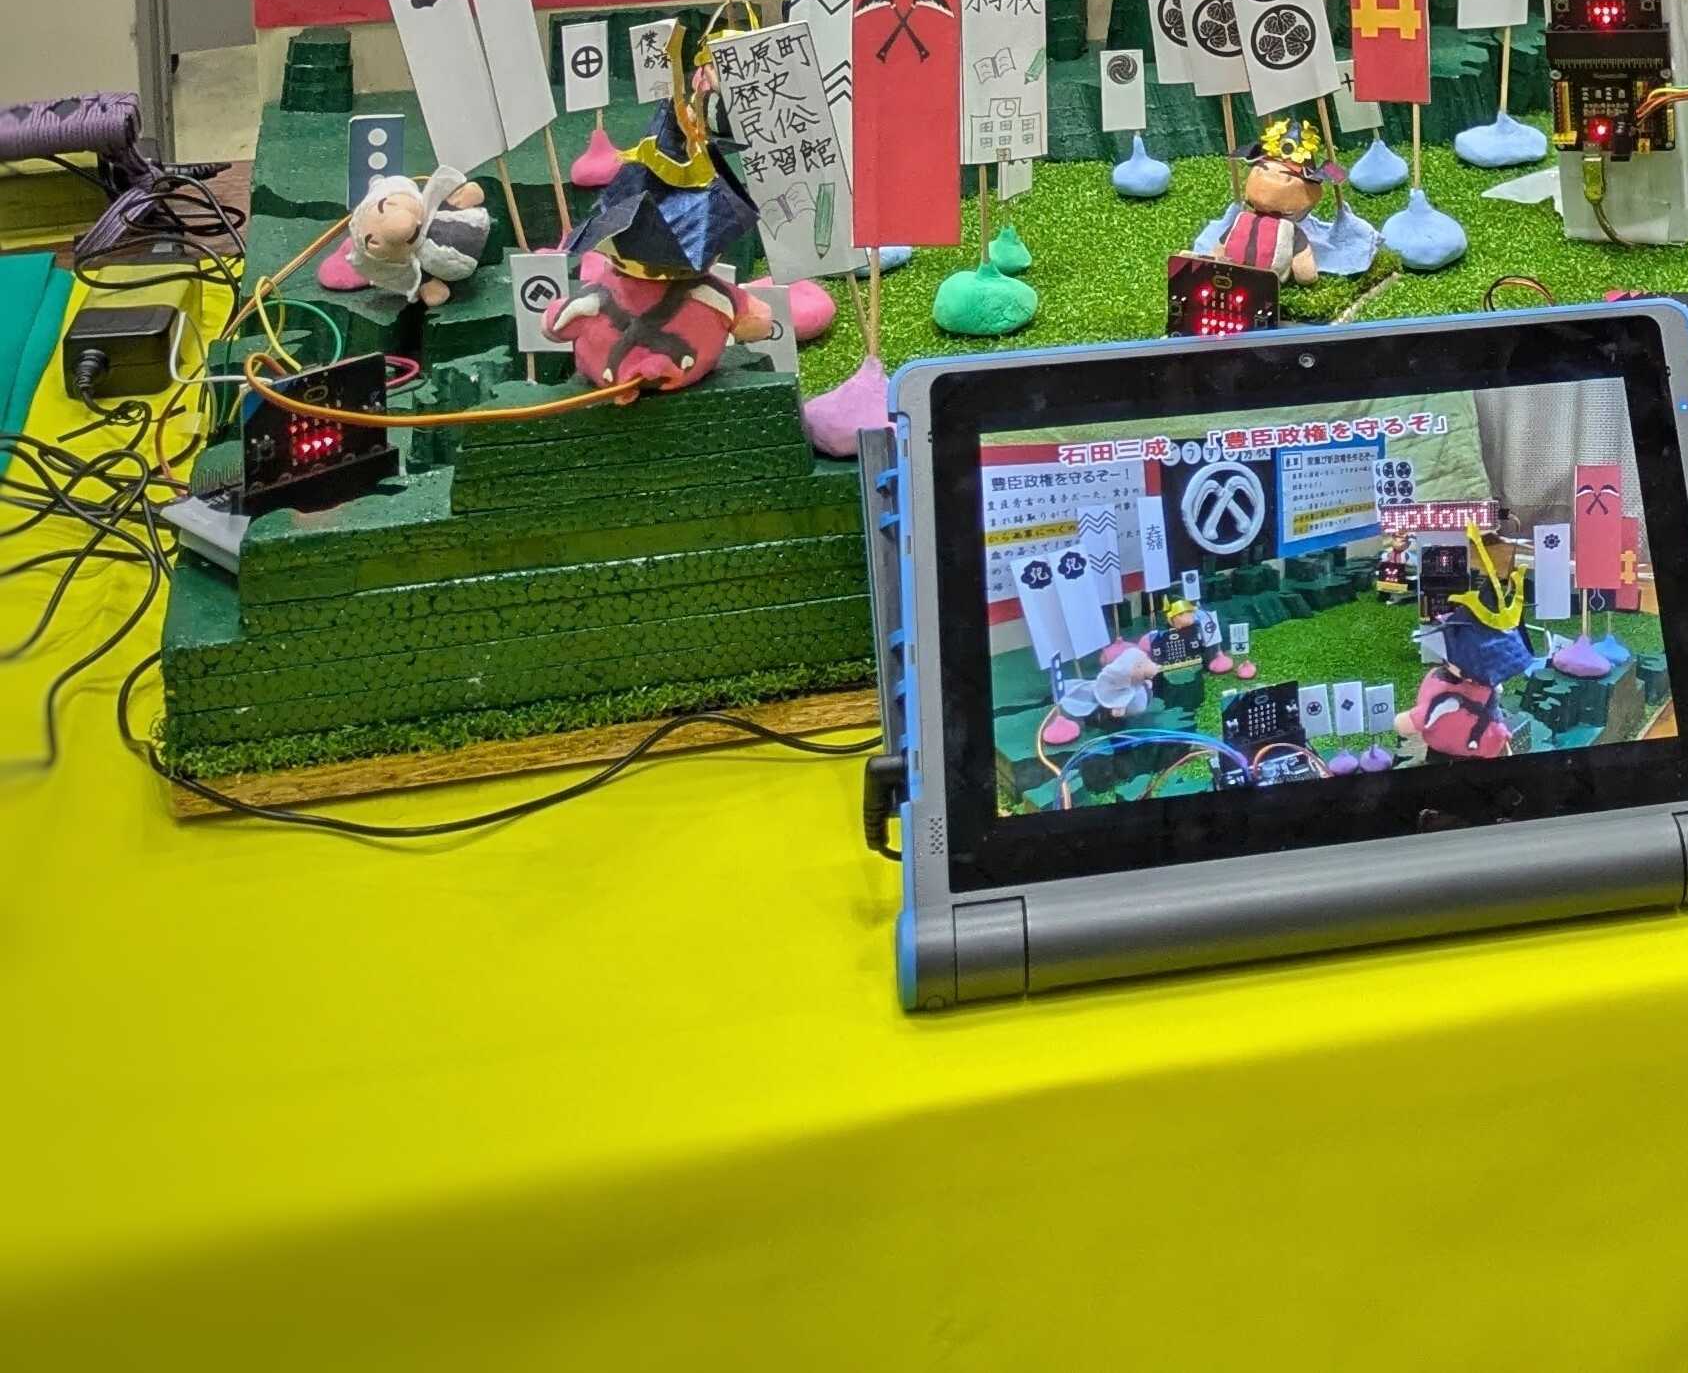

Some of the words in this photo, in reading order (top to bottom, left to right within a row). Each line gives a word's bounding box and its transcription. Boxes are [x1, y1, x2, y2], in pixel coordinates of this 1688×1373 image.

[726, 71, 807, 115] 歴史
[738, 104, 820, 148] 民俗
[742, 137, 837, 183] 学習館
[1060, 438, 1170, 465] 石田三成
